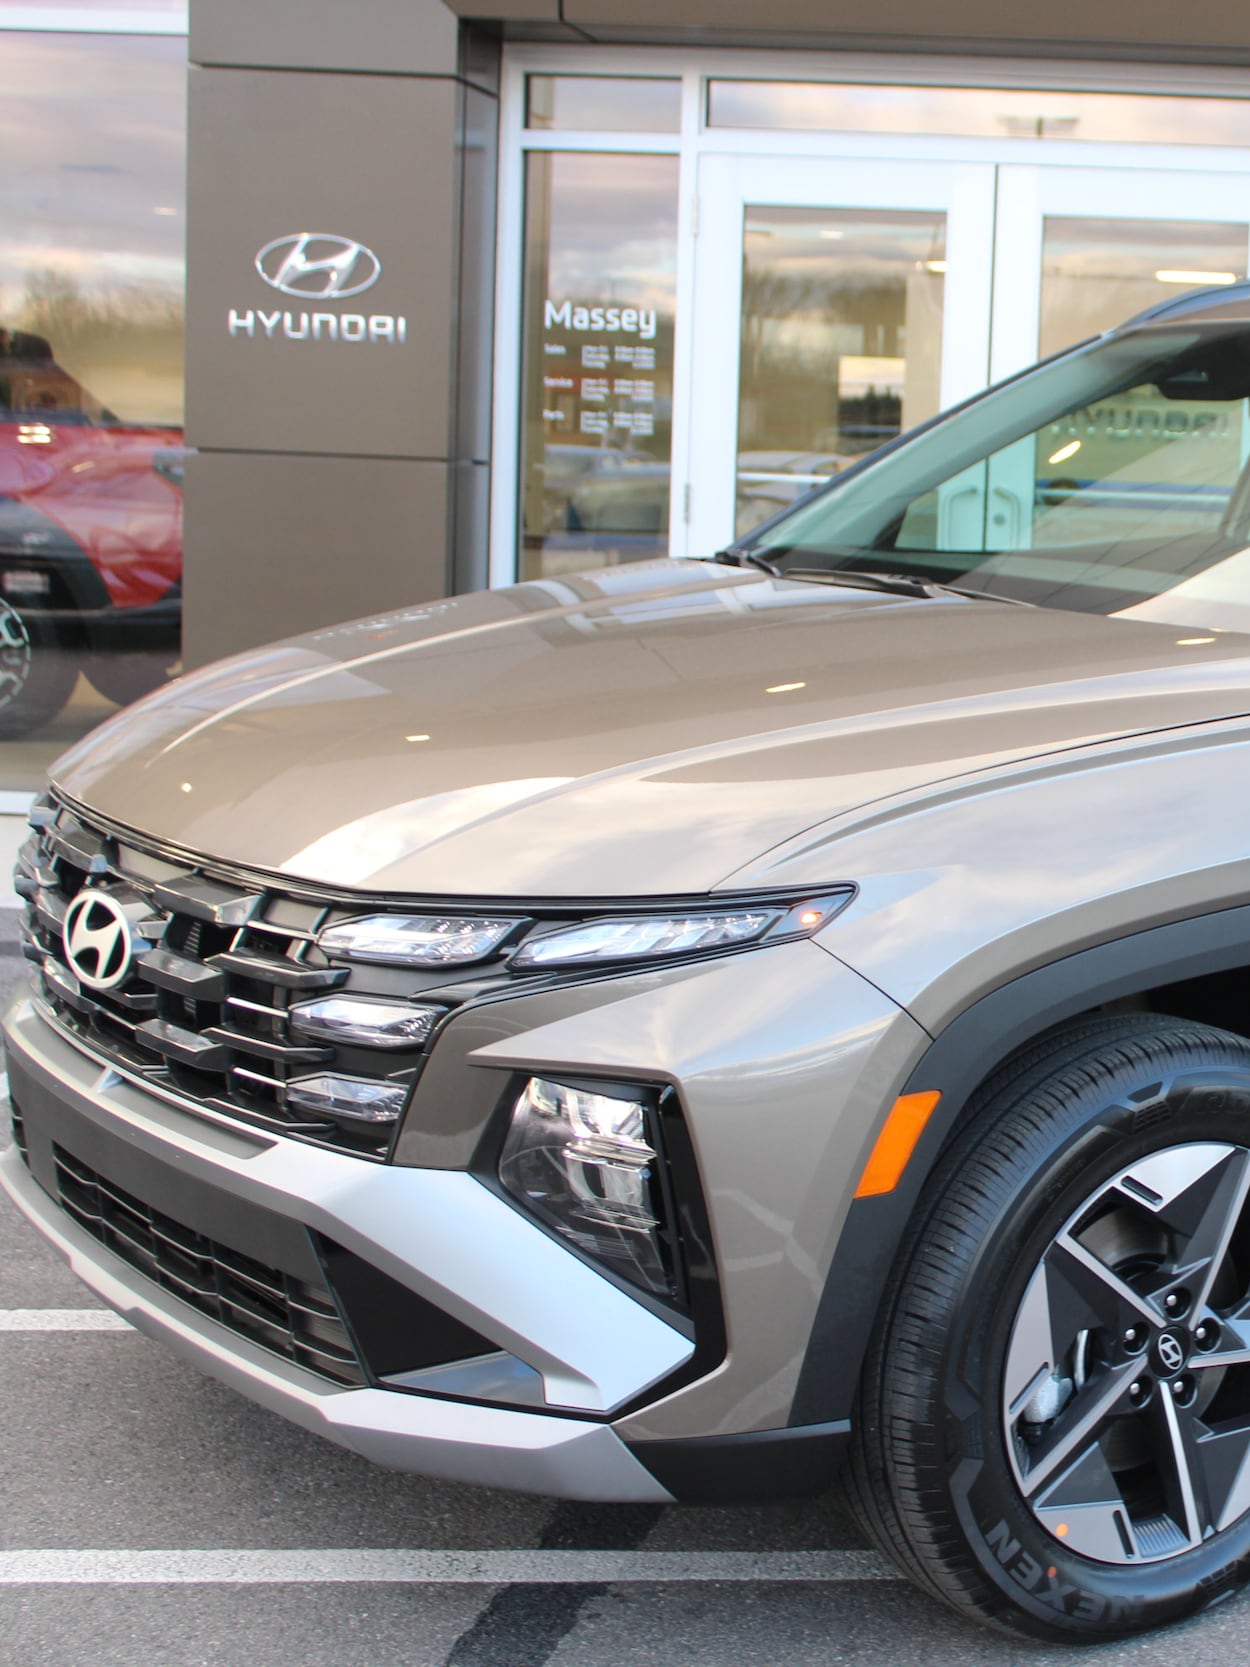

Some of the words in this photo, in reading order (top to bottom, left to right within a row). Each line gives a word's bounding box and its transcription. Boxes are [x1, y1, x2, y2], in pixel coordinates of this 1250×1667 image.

[228, 309, 407, 344] HYUNDAI
[544, 299, 657, 340] Massey
[984, 1519, 1145, 1622] NEXEN
